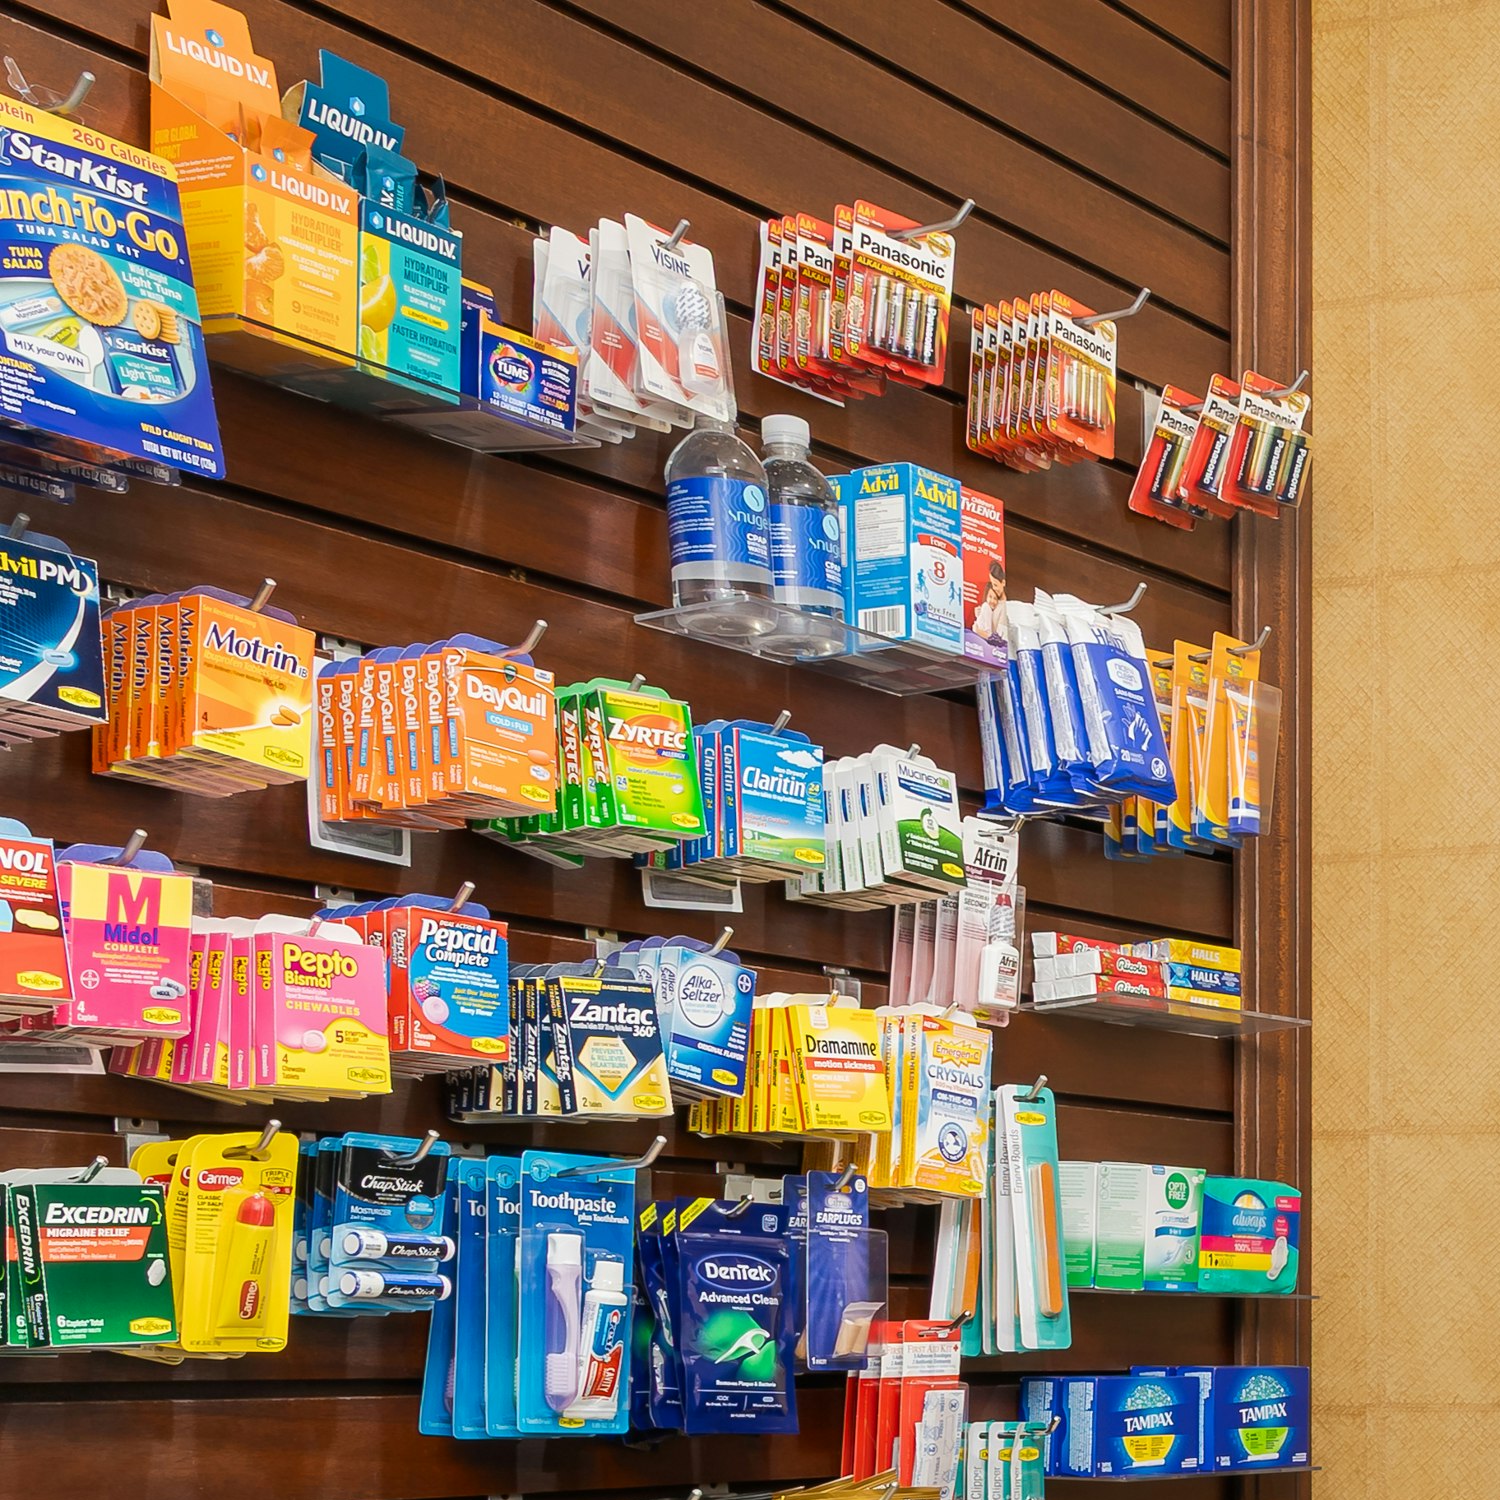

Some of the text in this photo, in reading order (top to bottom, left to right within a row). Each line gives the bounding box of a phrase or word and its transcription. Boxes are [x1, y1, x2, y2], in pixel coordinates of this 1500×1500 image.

[165, 30, 243, 77] LIQUID
[72, 128, 106, 151] 260
[110, 142, 168, 176] Calories
[9, 131, 149, 205] StarKist
[16, 223, 140, 259] TUNA SALAD KIT
[386, 217, 438, 250] LIQUID
[650, 244, 692, 279] VISINE
[859, 233, 946, 279] Panasonic
[403, 256, 448, 283] HYDRATION
[403, 270, 450, 295] MULTIPLIER
[496, 359, 530, 382] TUMS
[914, 481, 958, 511] Advil
[961, 494, 1001, 523] TYLENOL
[204, 622, 297, 676] Motrin
[466, 675, 547, 716] DayQuil
[608, 716, 688, 750] ZYRTEC
[742, 766, 806, 798] Claritin
[973, 847, 1009, 873] Afrin
[104, 924, 160, 946] Midol
[419, 918, 499, 955] Pepcid
[103, 943, 160, 955] COMPLETE
[425, 947, 490, 968] Complete
[283, 943, 358, 979] Pepto
[1115, 957, 1148, 975] Ricola
[283, 971, 333, 990] Bismol
[684, 974, 717, 990] Alka-
[1190, 971, 1220, 986] HALLS
[680, 987, 722, 1003] Seltzer
[285, 1000, 361, 1017] CHEWABLES
[570, 998, 654, 1026] Zantac
[806, 1034, 878, 1057] Dramamine
[934, 1044, 981, 1062] Emergen-C
[813, 1059, 876, 1071] motion sickness
[928, 1064, 984, 1089] CRYSTALS
[1011, 1128, 1023, 1194] Emery Boards
[198, 1171, 244, 1188] Carmex
[361, 1174, 424, 1194] ChapStick
[45, 1202, 150, 1225] EXCEDRIN
[529, 1189, 617, 1215] Toothpaste
[592, 1214, 630, 1226] Toothbrush
[816, 1212, 863, 1226] EARPLUGS
[1231, 1213, 1267, 1231] always
[46, 1226, 130, 1238] MIGRAINE RELIEF
[705, 1262, 772, 1283] DenTek
[699, 1291, 779, 1306] Advanced Clean
[1124, 1410, 1174, 1433] TAMPAX
